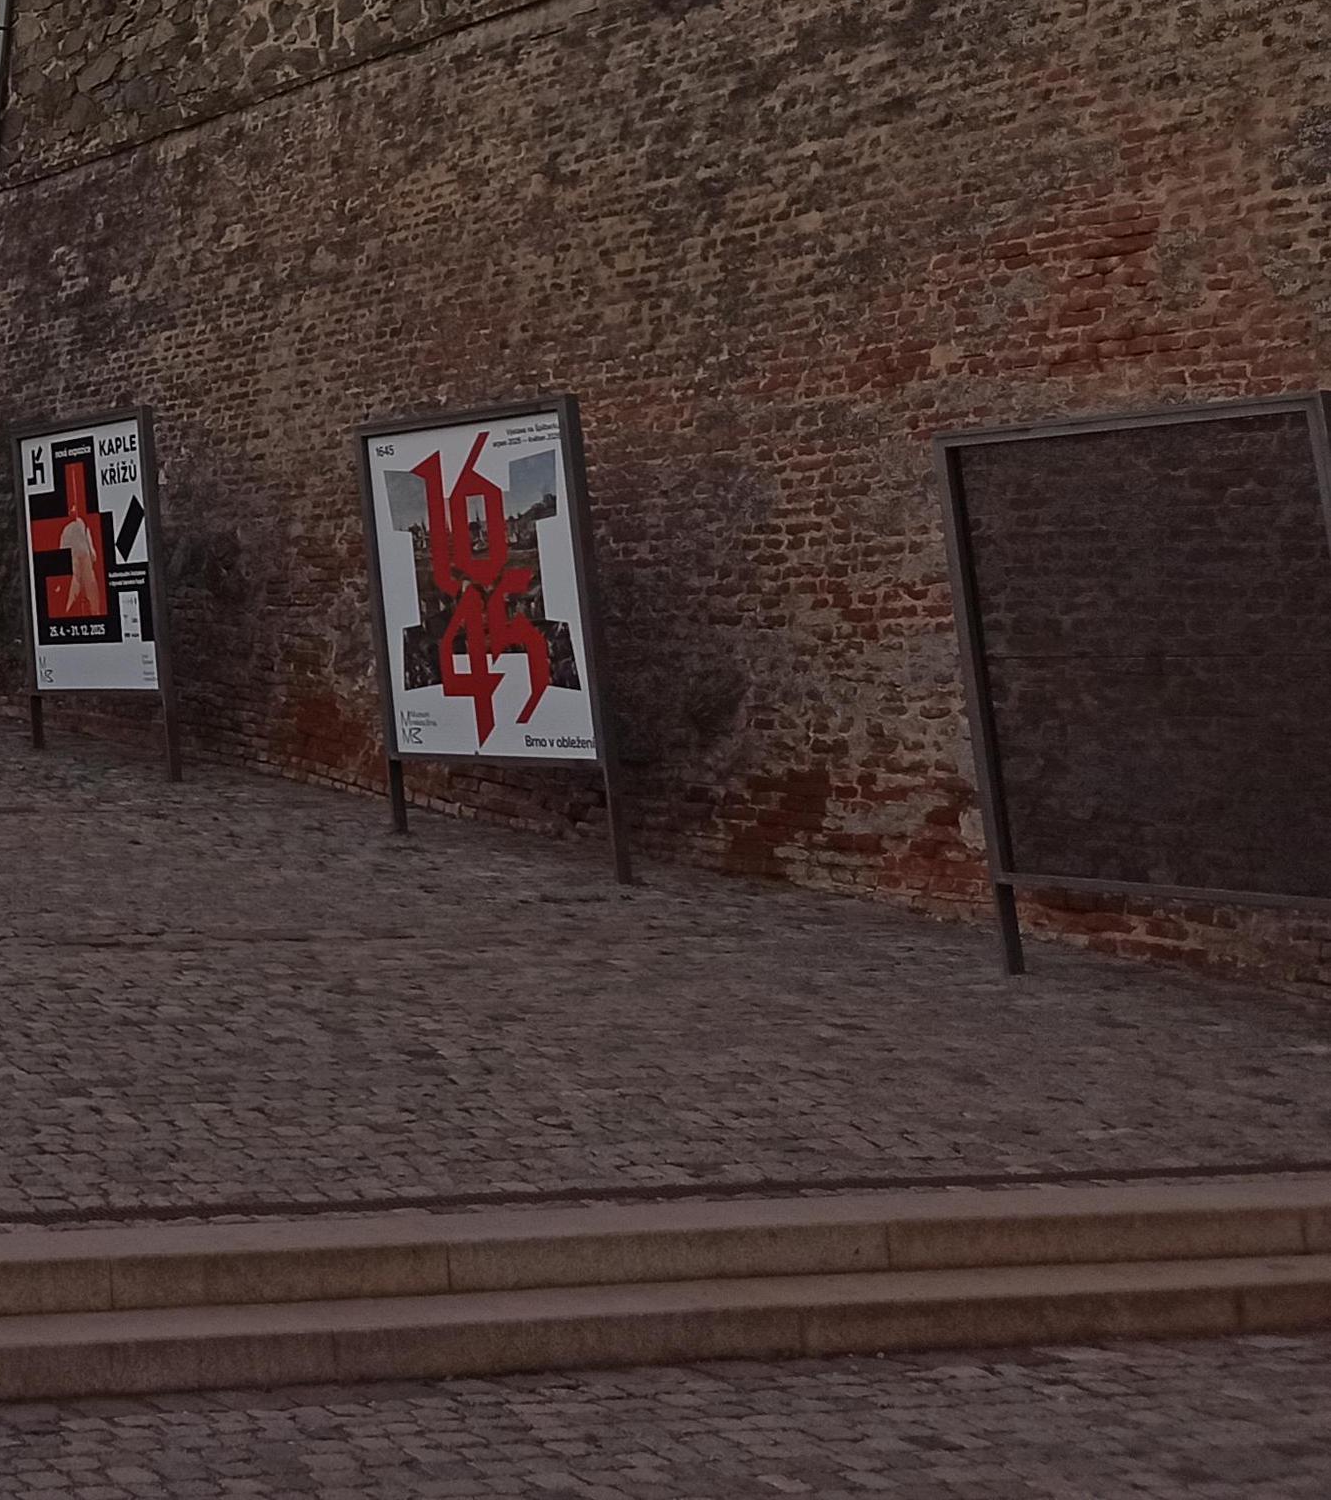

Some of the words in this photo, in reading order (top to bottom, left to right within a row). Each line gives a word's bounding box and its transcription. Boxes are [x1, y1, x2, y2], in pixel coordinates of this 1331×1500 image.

[98, 434, 137, 457] KAPLE
[375, 444, 395, 457] 1645
[100, 459, 137, 486] KŘÍŽŮ
[524, 734, 547, 748] Brno
[548, 738, 555, 748] v
